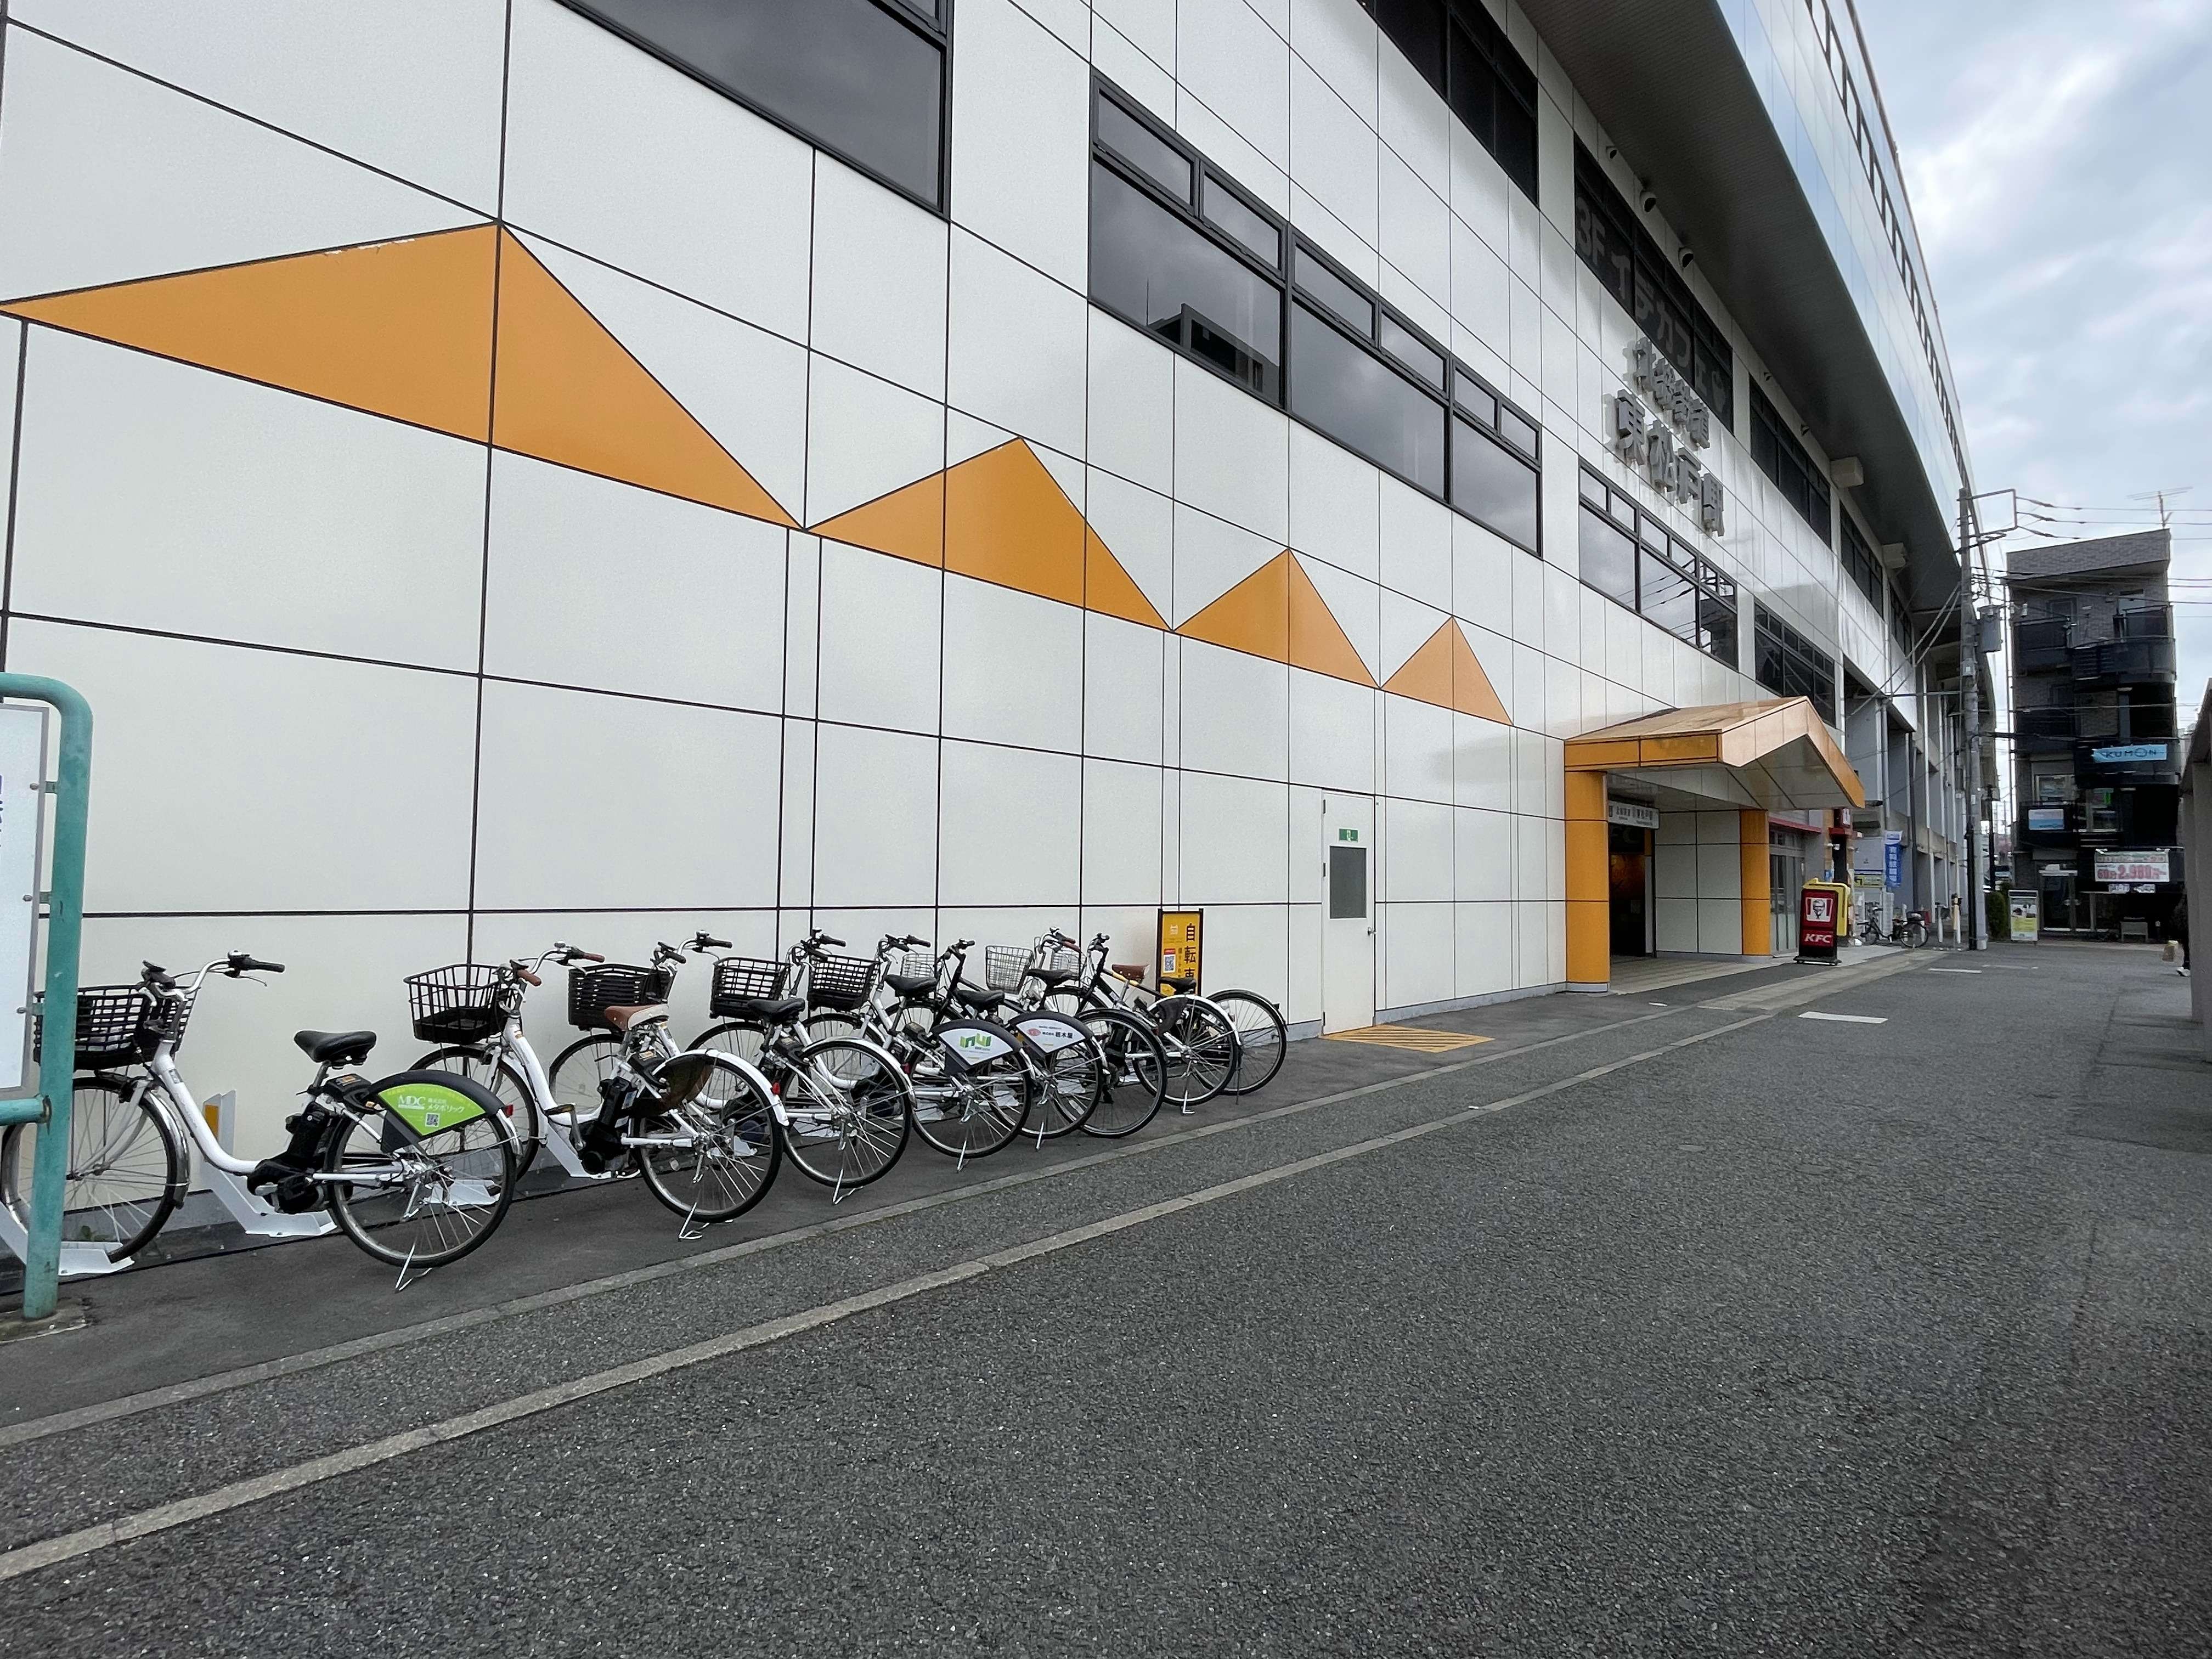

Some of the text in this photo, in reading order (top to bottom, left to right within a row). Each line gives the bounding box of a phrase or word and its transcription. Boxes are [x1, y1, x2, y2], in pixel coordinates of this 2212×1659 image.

[1615, 389, 1725, 537] 東松戸駅
[2104, 747, 2157, 758] KUMON
[1804, 934, 1832, 944] KFC
[398, 1094, 426, 1107] MDC
